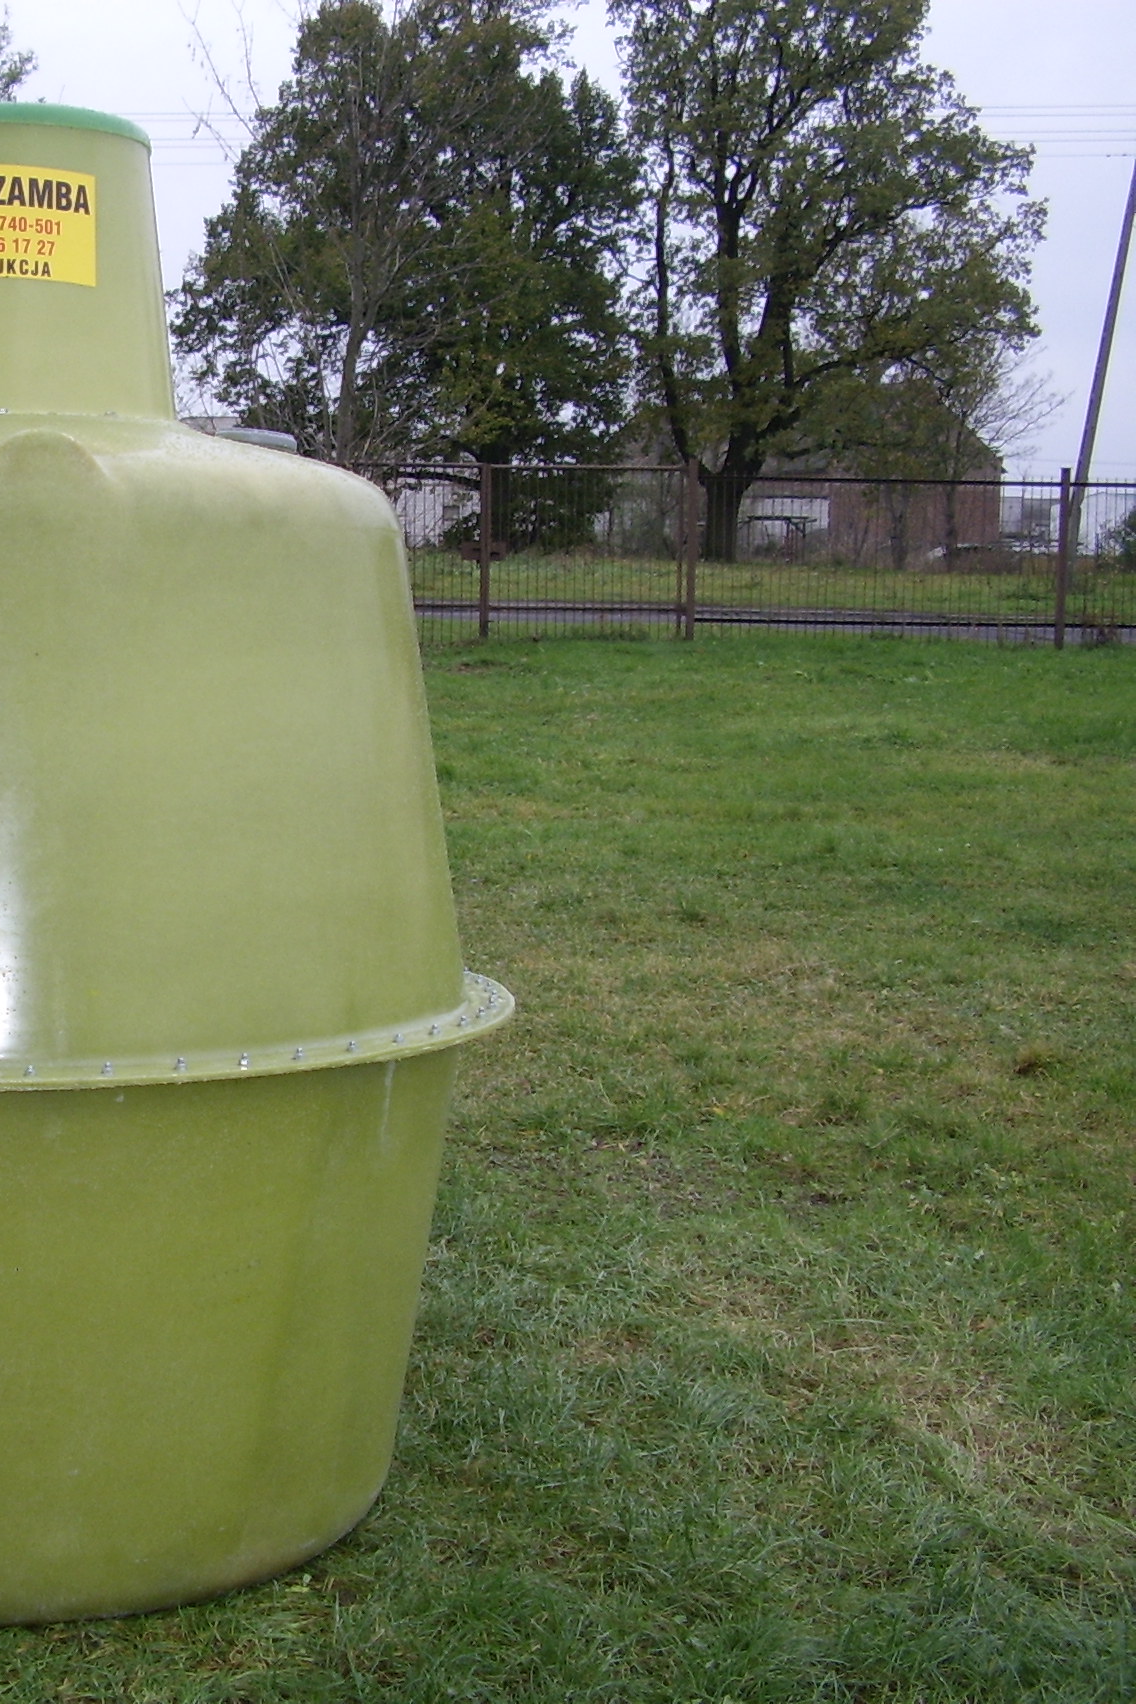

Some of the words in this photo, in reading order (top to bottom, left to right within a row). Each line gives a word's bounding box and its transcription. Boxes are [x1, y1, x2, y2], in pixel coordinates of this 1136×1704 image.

[0, 216, 62, 235] 740-501
[13, 239, 31, 254] 17
[36, 239, 55, 256] 27
